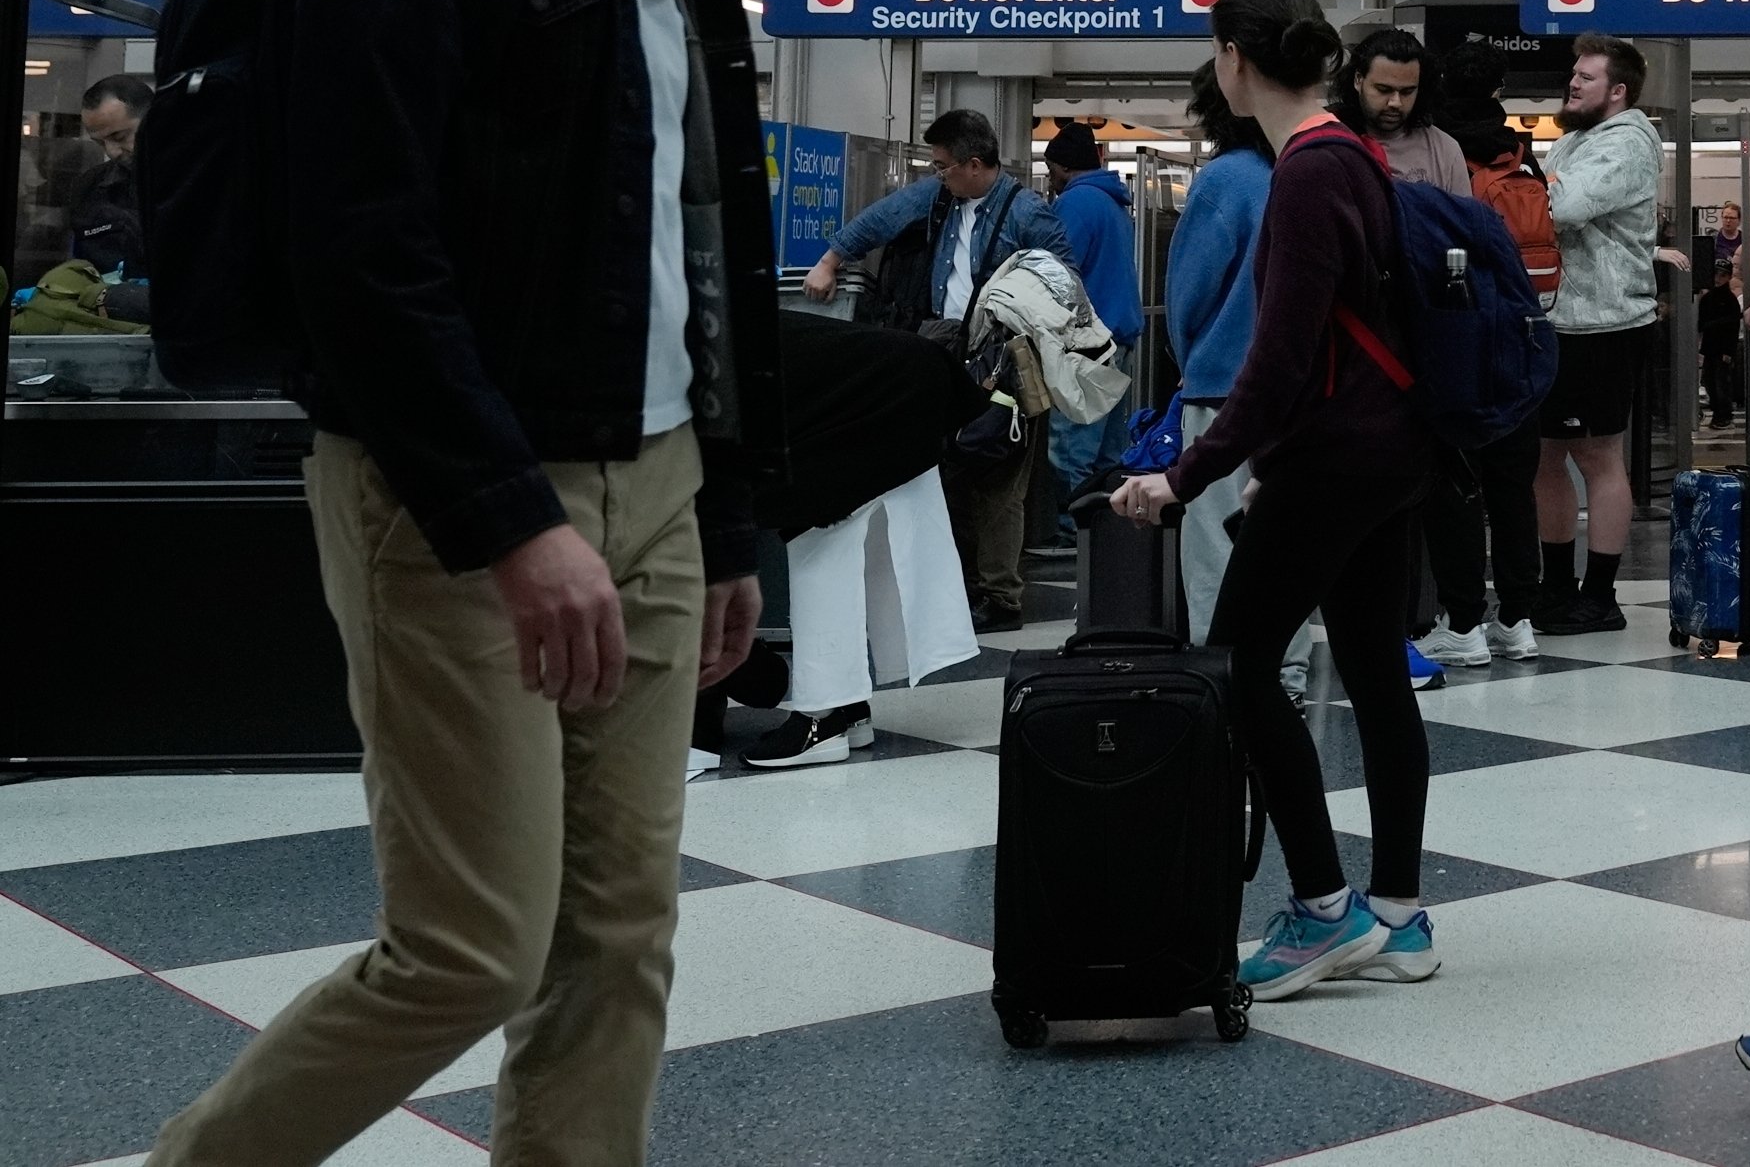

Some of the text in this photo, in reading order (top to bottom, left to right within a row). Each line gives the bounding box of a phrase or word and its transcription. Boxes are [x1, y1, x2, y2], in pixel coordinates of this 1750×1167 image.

[871, 5, 1164, 35] Security Checkpoint 1
[1488, 35, 1541, 51] leidos
[794, 147, 841, 180] Stack your
[793, 182, 839, 212] empty bin
[792, 214, 837, 241] to the left
